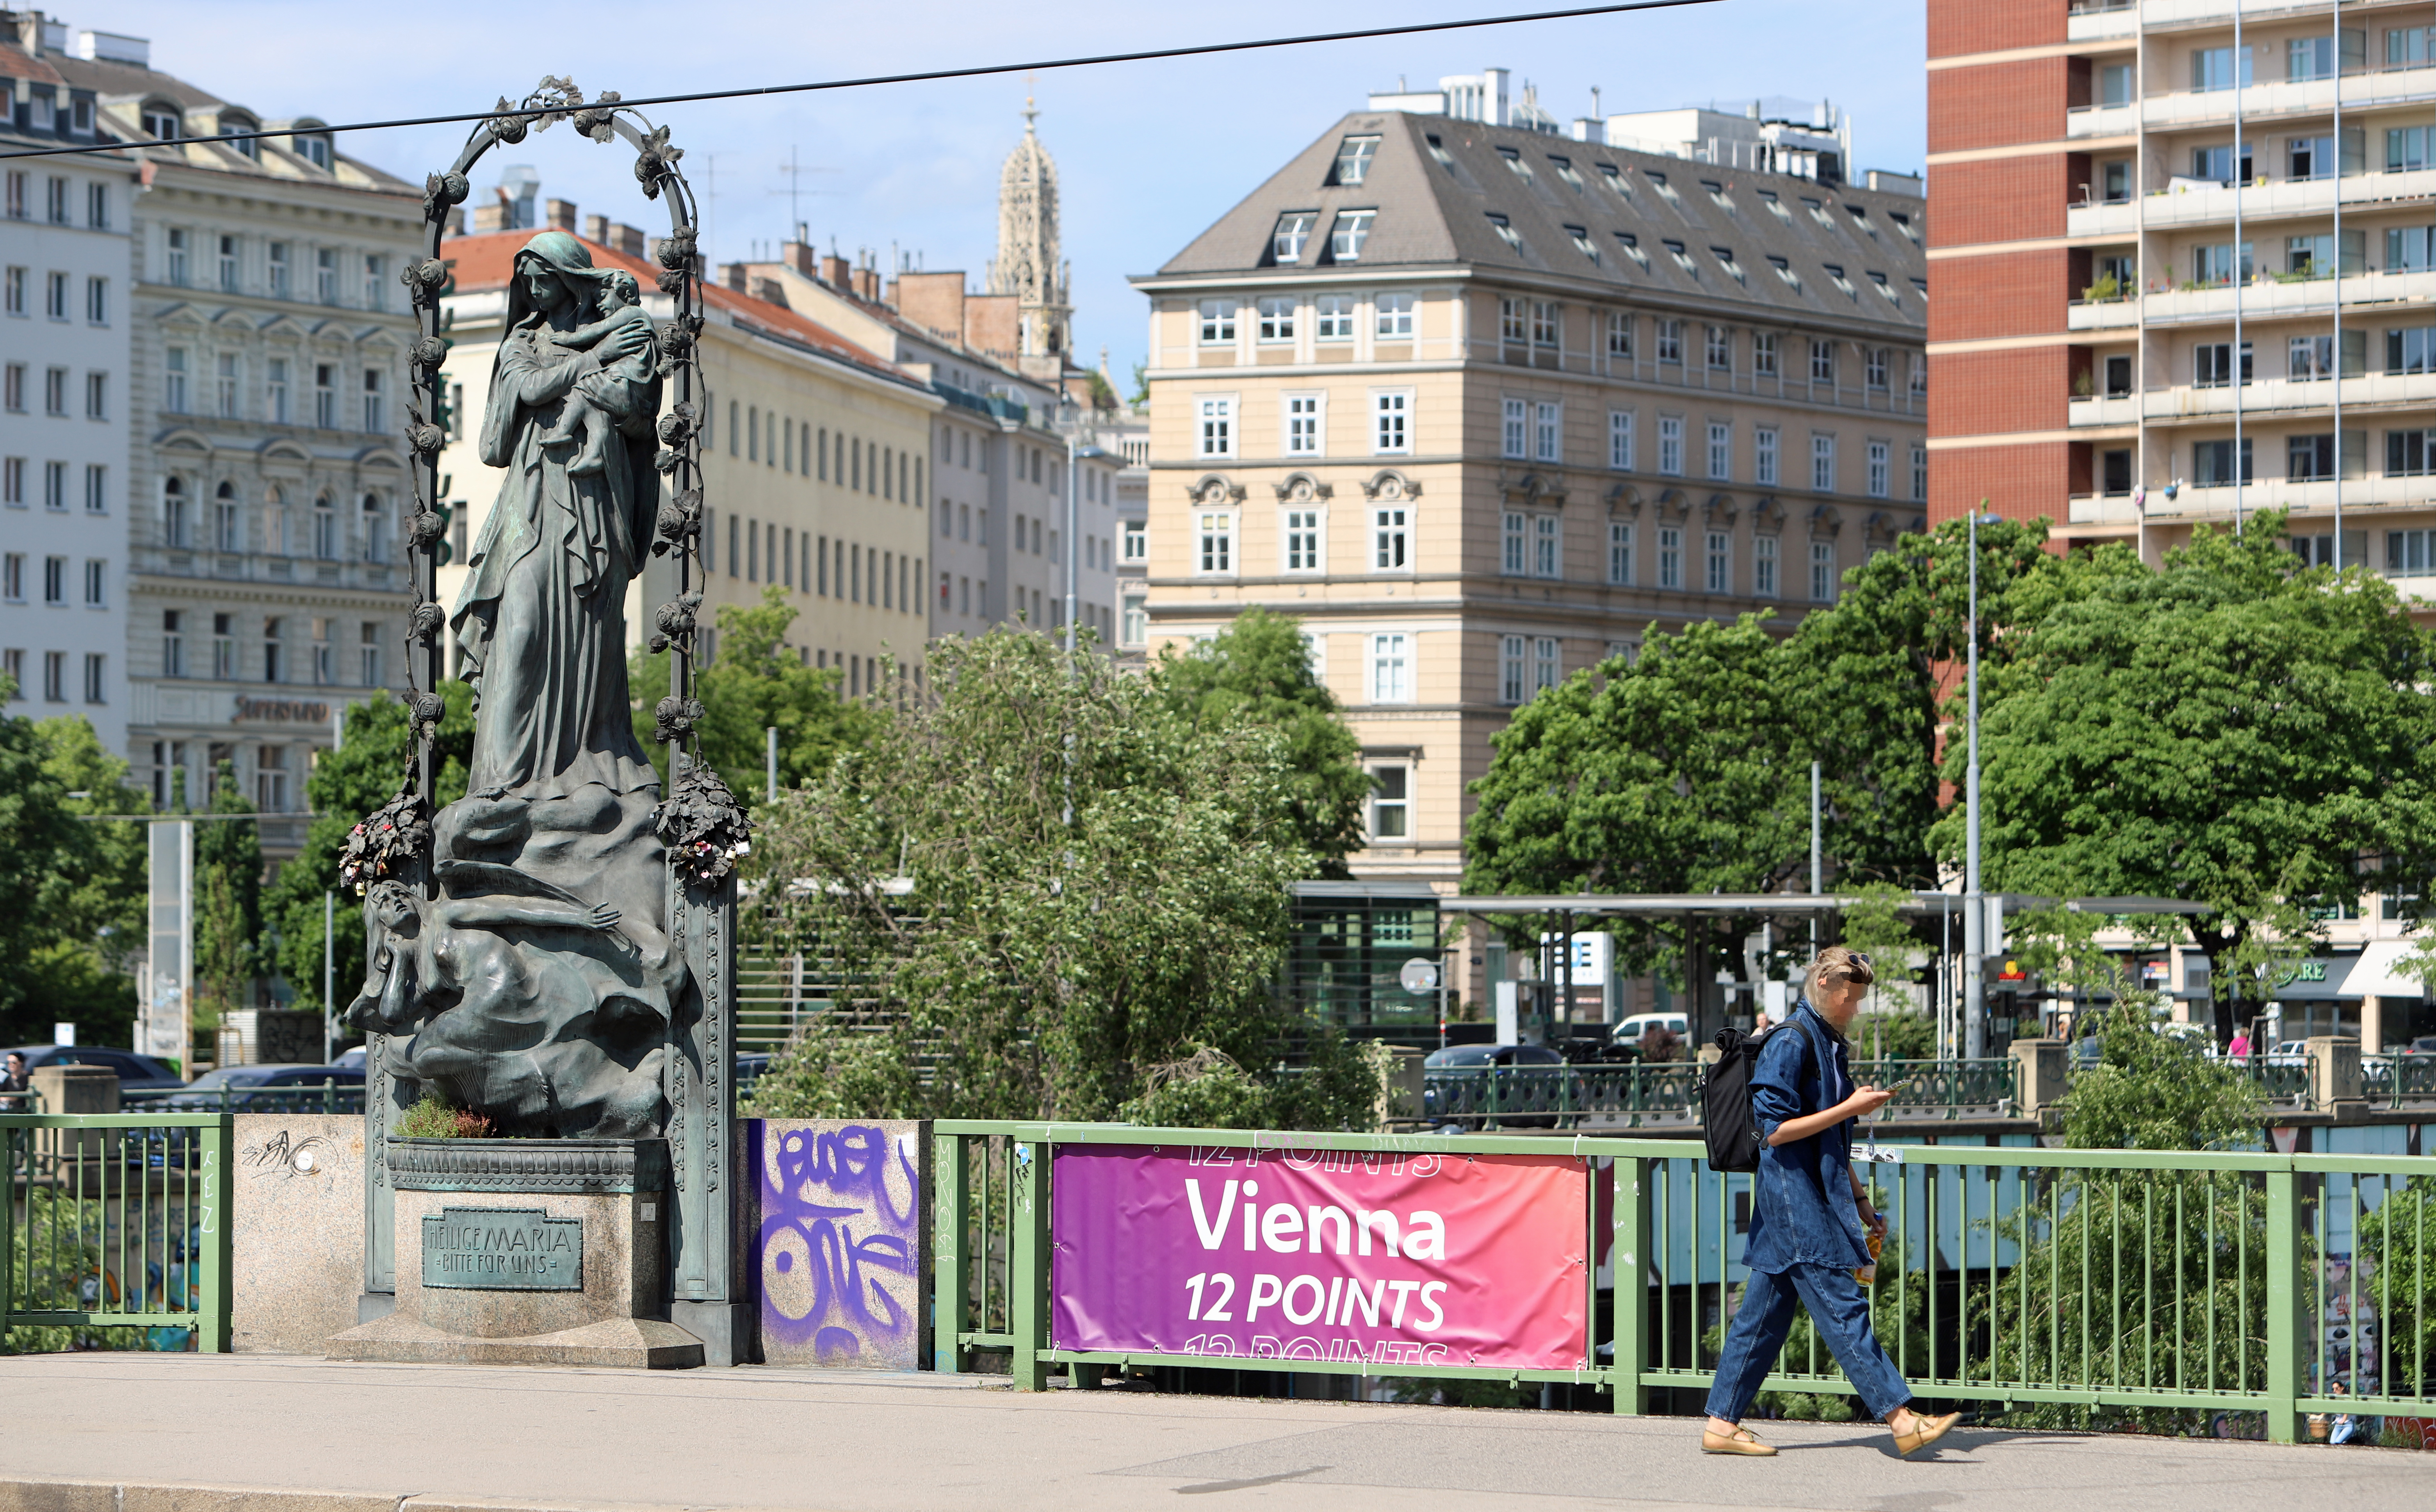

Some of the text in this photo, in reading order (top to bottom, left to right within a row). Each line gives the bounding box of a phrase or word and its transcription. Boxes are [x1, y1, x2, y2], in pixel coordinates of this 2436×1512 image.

[429, 1226, 571, 1252] HEILIGE MARIA
[1184, 1178, 1445, 1260] Vienna
[442, 1253, 472, 1272] BITTE
[511, 1255, 547, 1274] UNS
[1185, 1272, 1448, 1332] 12 POINTS
